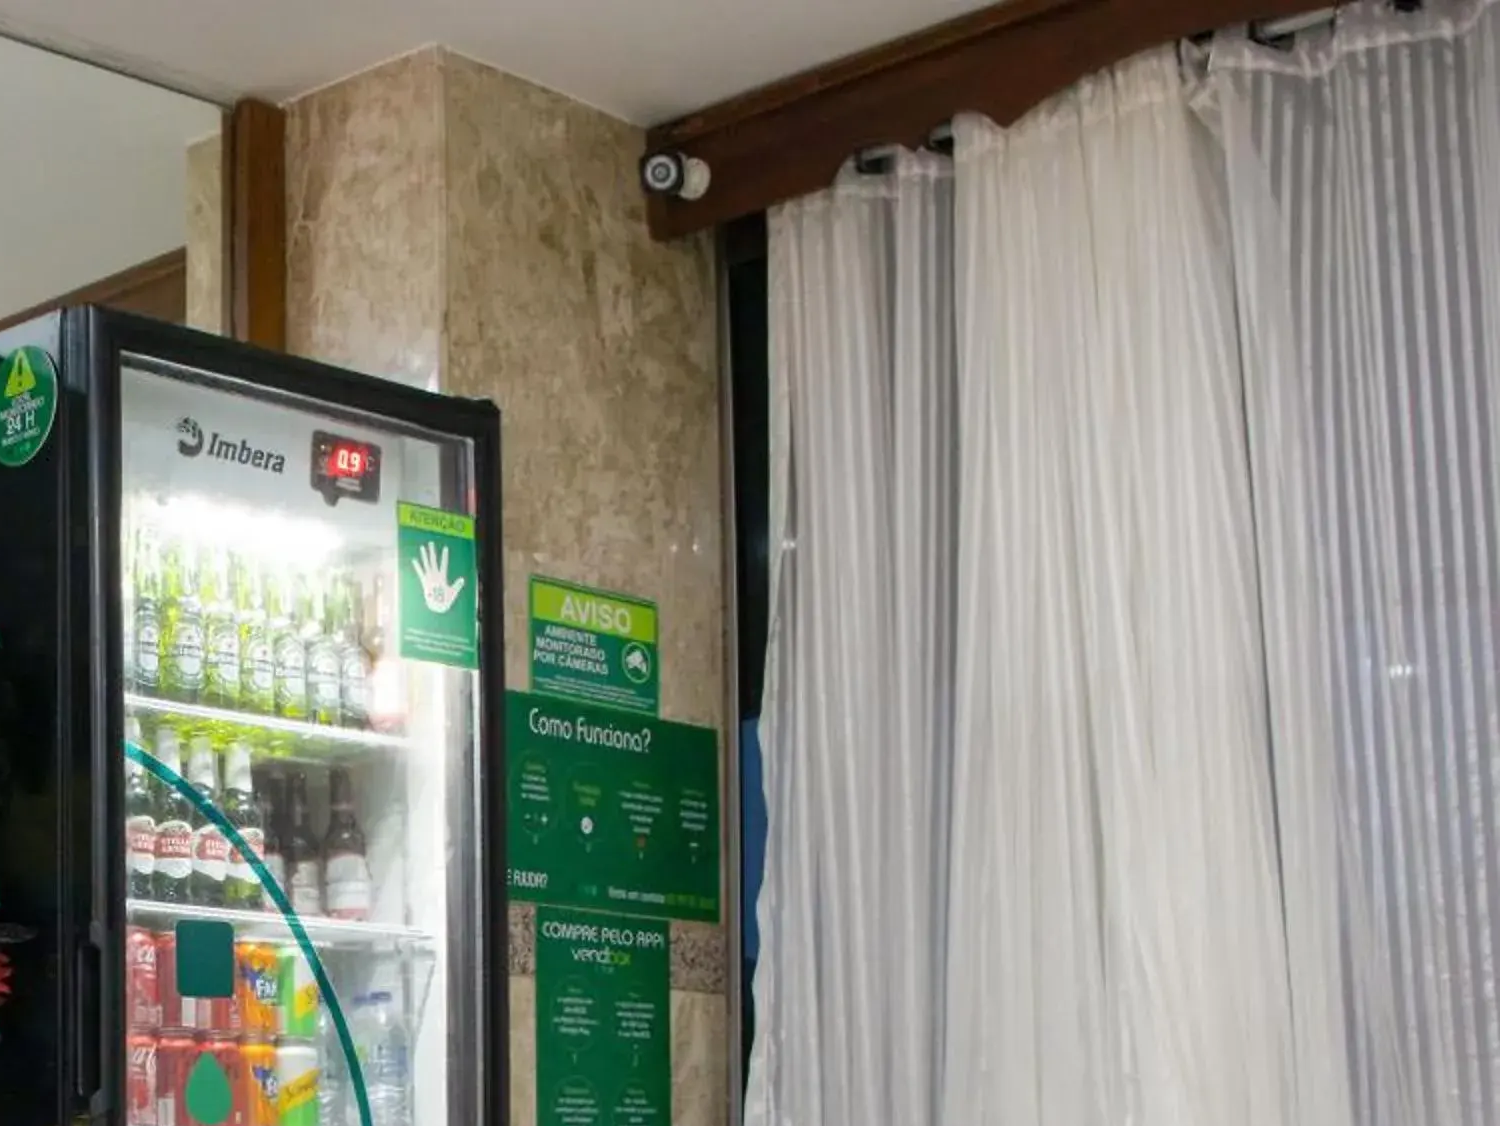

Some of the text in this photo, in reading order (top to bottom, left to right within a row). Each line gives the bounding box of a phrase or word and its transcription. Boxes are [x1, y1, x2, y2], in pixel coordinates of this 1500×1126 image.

[207, 432, 285, 475] Imbera
[561, 594, 631, 634] AVISO
[536, 635, 605, 661] MONITORADO
[529, 707, 651, 754] Como Funciona?
[542, 921, 599, 943] COMPRE
[601, 927, 634, 946] PELO
